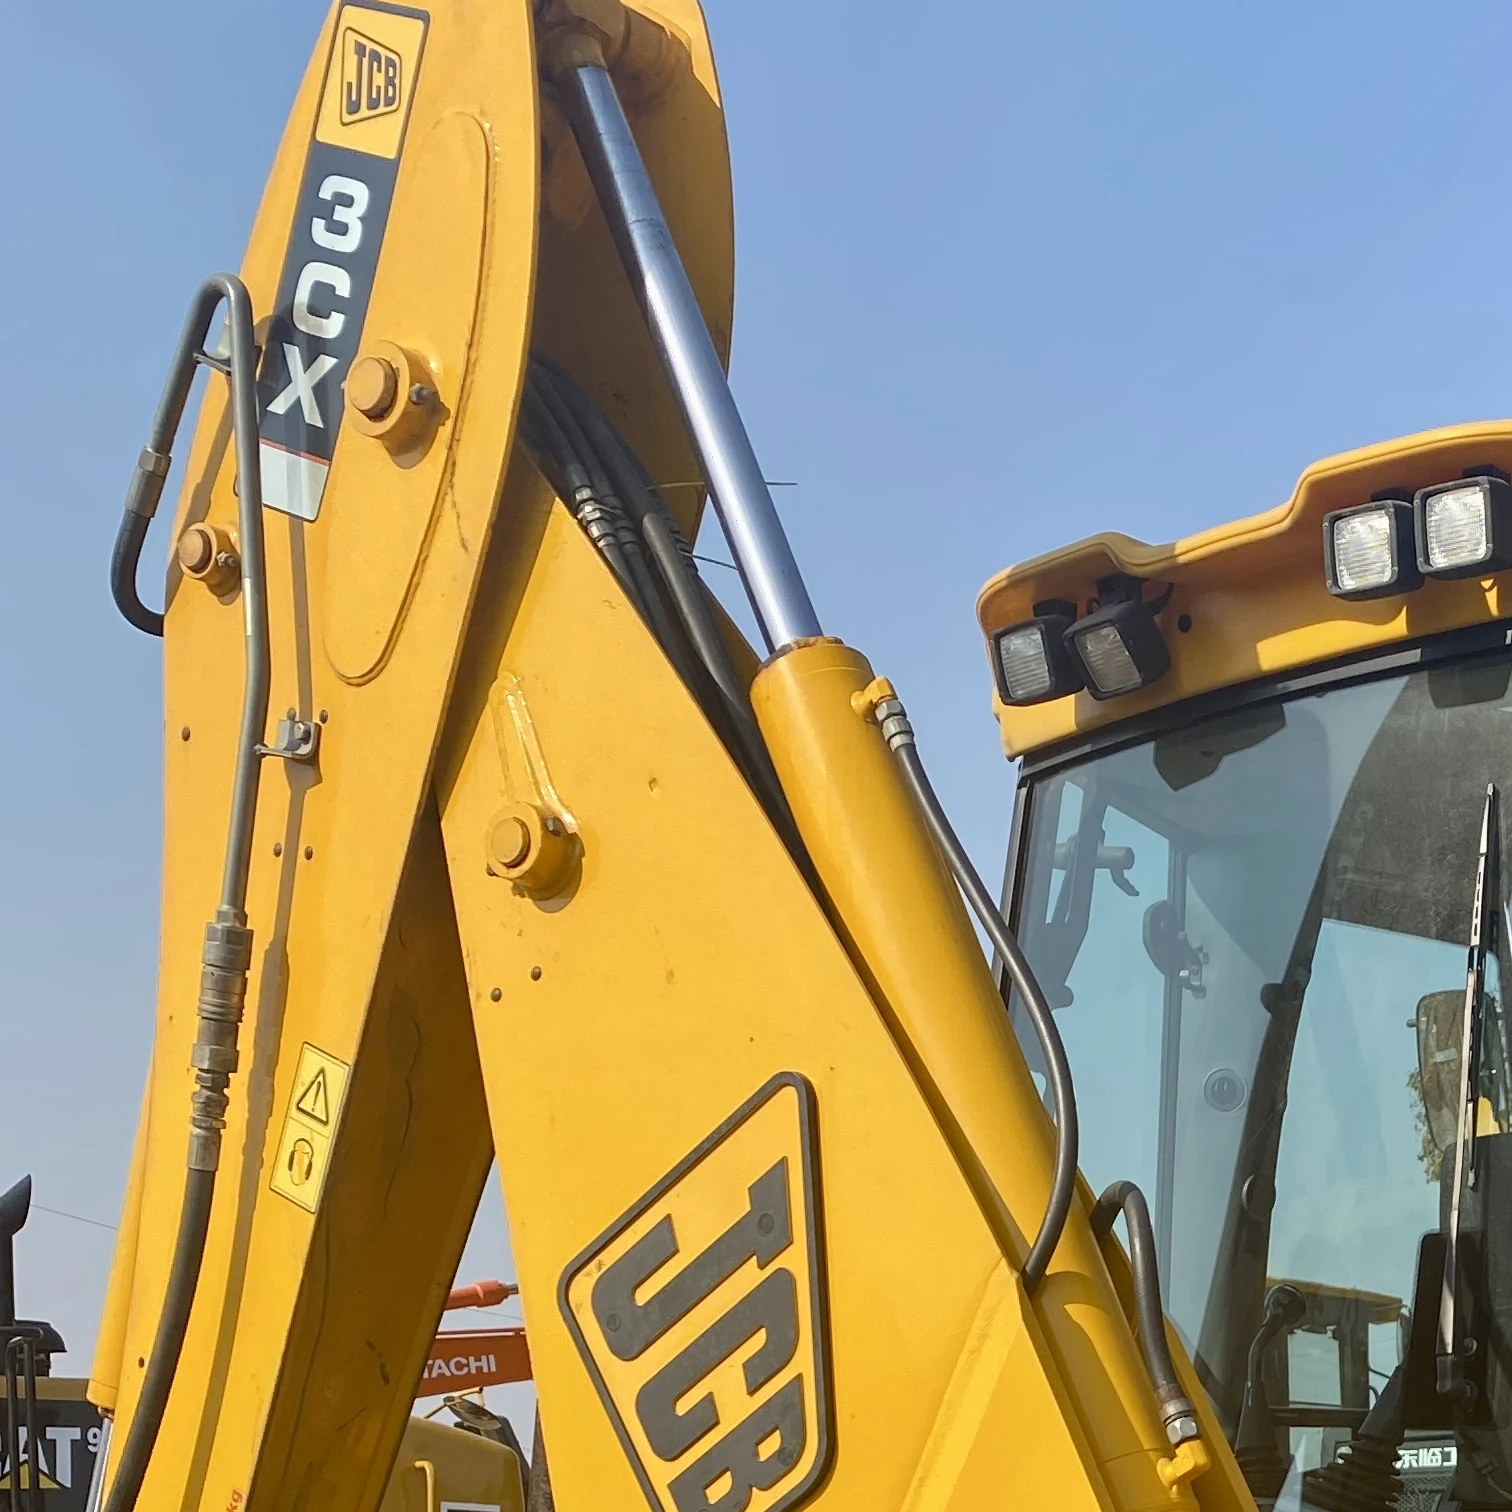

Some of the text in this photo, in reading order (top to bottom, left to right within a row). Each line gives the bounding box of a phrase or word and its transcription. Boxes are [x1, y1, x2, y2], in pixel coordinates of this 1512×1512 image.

[345, 39, 399, 116] JCB
[265, 174, 370, 429] 3CX
[0, 1426, 81, 1489] AT
